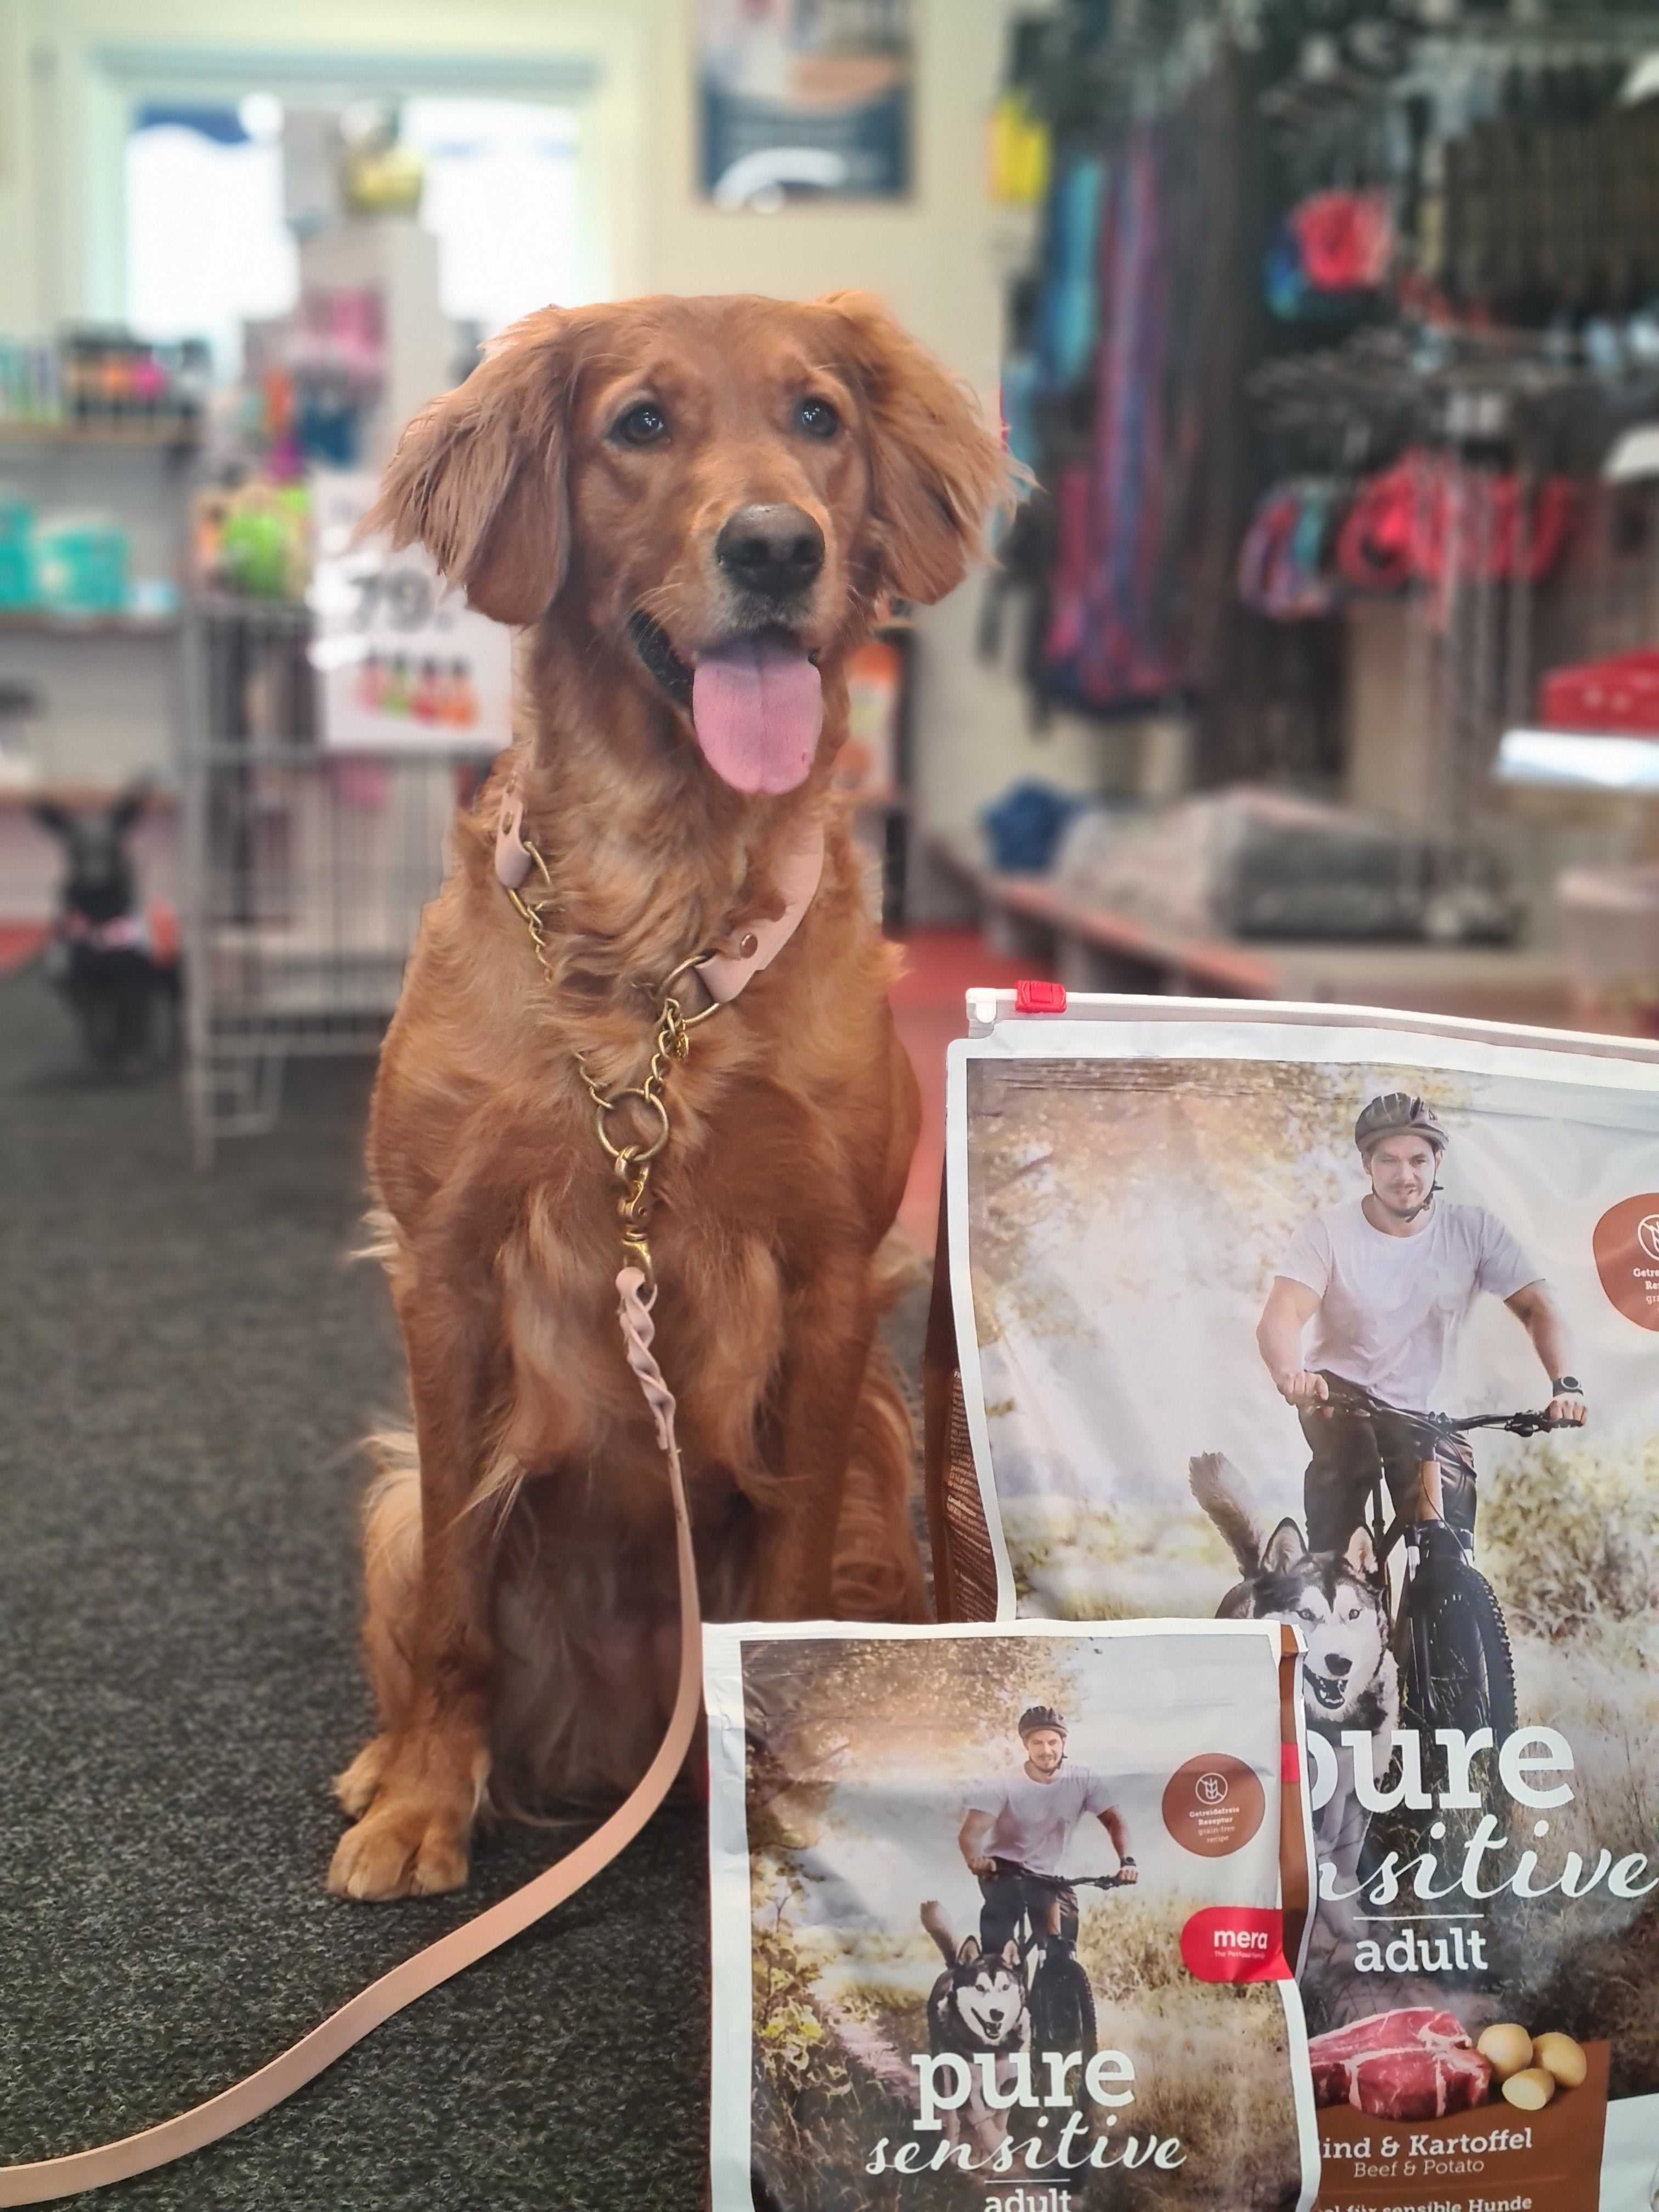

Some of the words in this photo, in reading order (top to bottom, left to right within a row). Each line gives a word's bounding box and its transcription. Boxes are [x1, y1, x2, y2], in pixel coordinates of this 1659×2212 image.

[1214, 1930, 1268, 1949] mera
[1353, 1928, 1489, 1973] adult
[911, 2049, 1136, 2131] pure
[865, 2110, 1188, 2175] sensitive
[1323, 2137, 1371, 2158] ind
[1380, 2136, 1400, 2157] &
[1408, 2128, 1532, 2157] Kartoffel
[1353, 2161, 1397, 2178] Beef
[1403, 2160, 1417, 2176] &
[1423, 2159, 1485, 2175] Potato
[984, 2188, 1072, 2212] adult
[1468, 2195, 1532, 2212] Hunde
